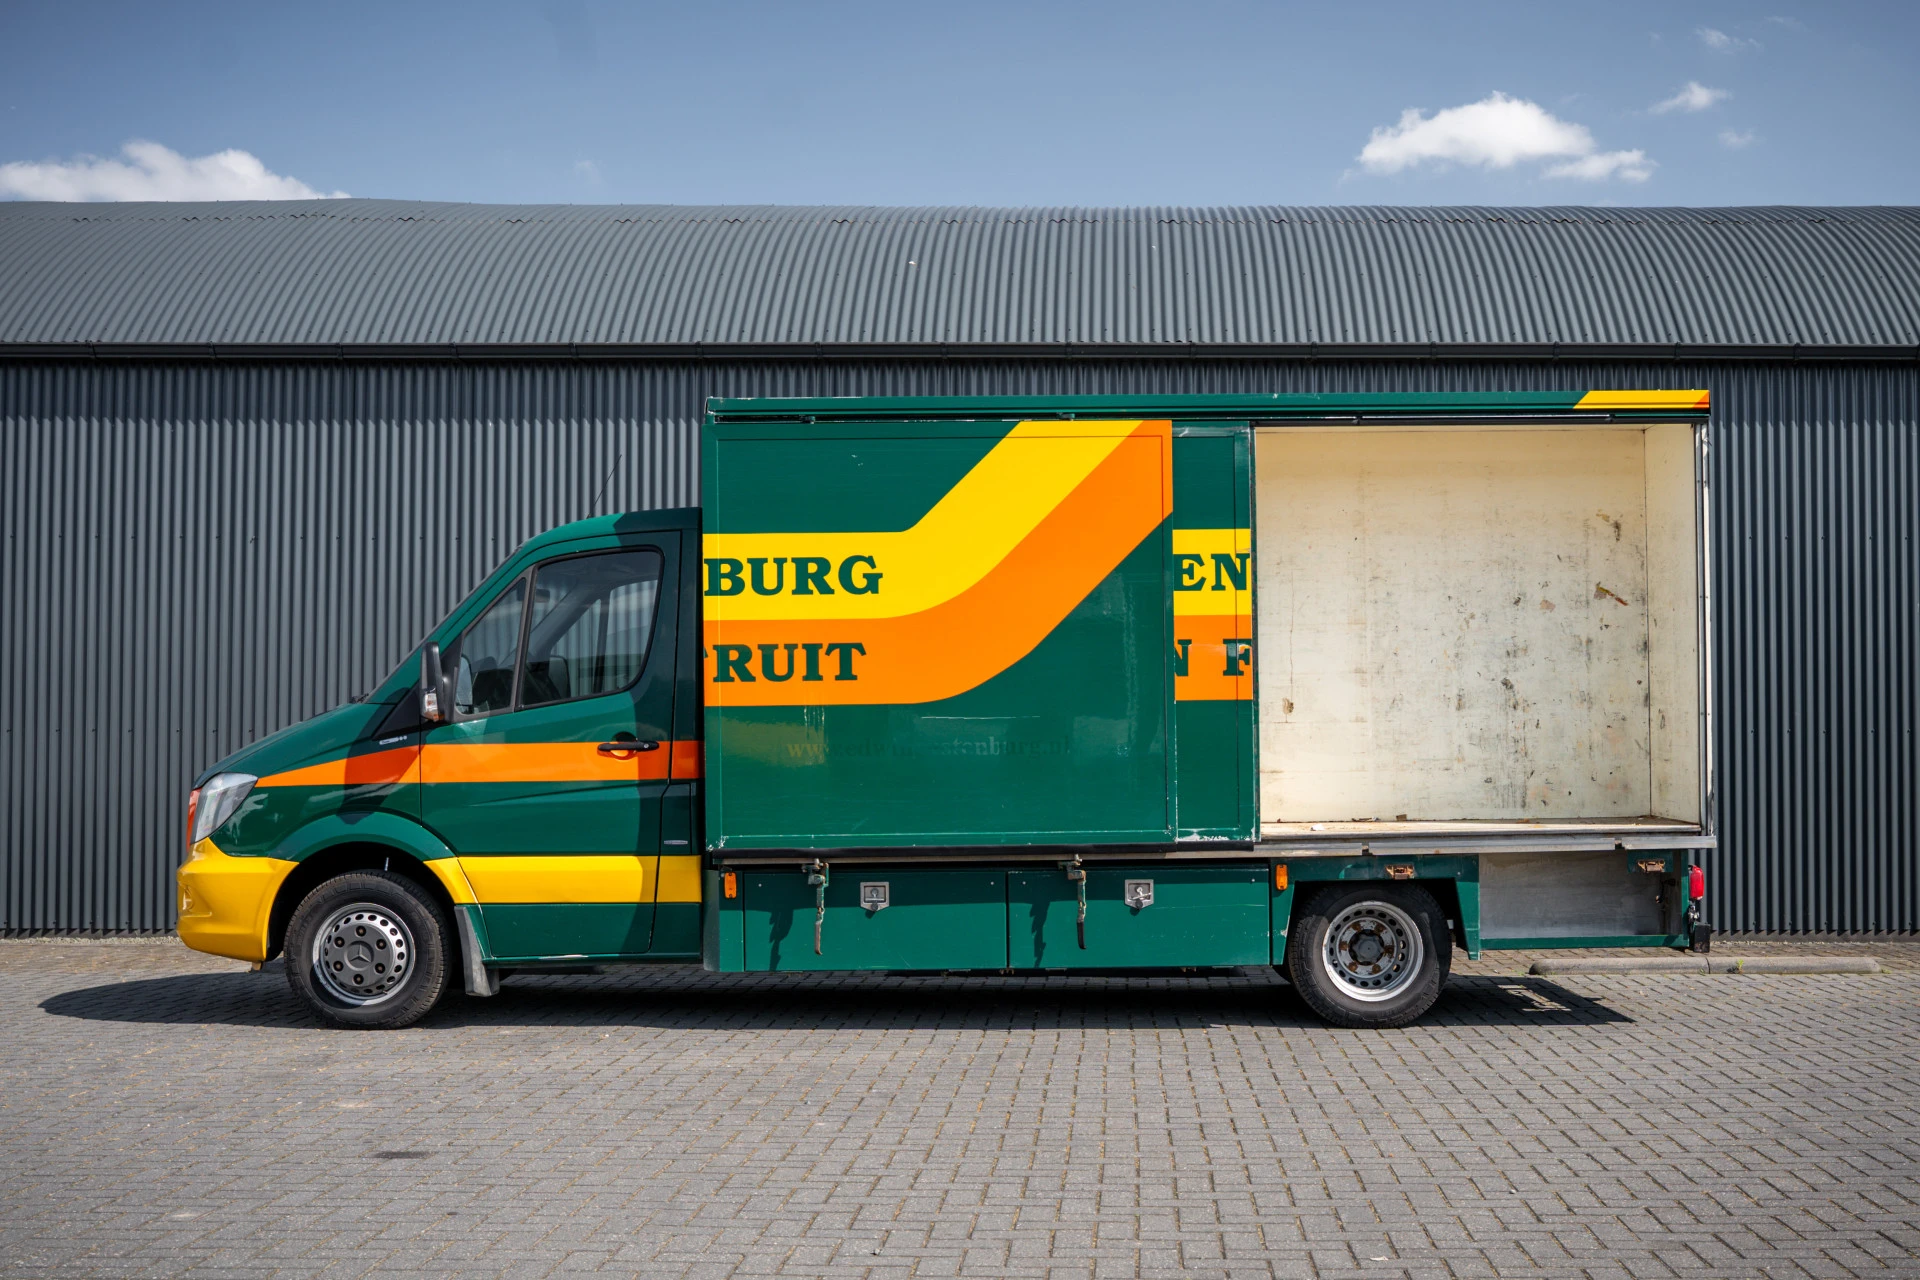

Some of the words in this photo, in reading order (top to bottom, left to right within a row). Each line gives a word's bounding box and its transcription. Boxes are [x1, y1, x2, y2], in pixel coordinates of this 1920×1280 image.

[704, 555, 883, 596] BURG
[1173, 553, 1250, 591] EN
[704, 642, 867, 682] RUIT
